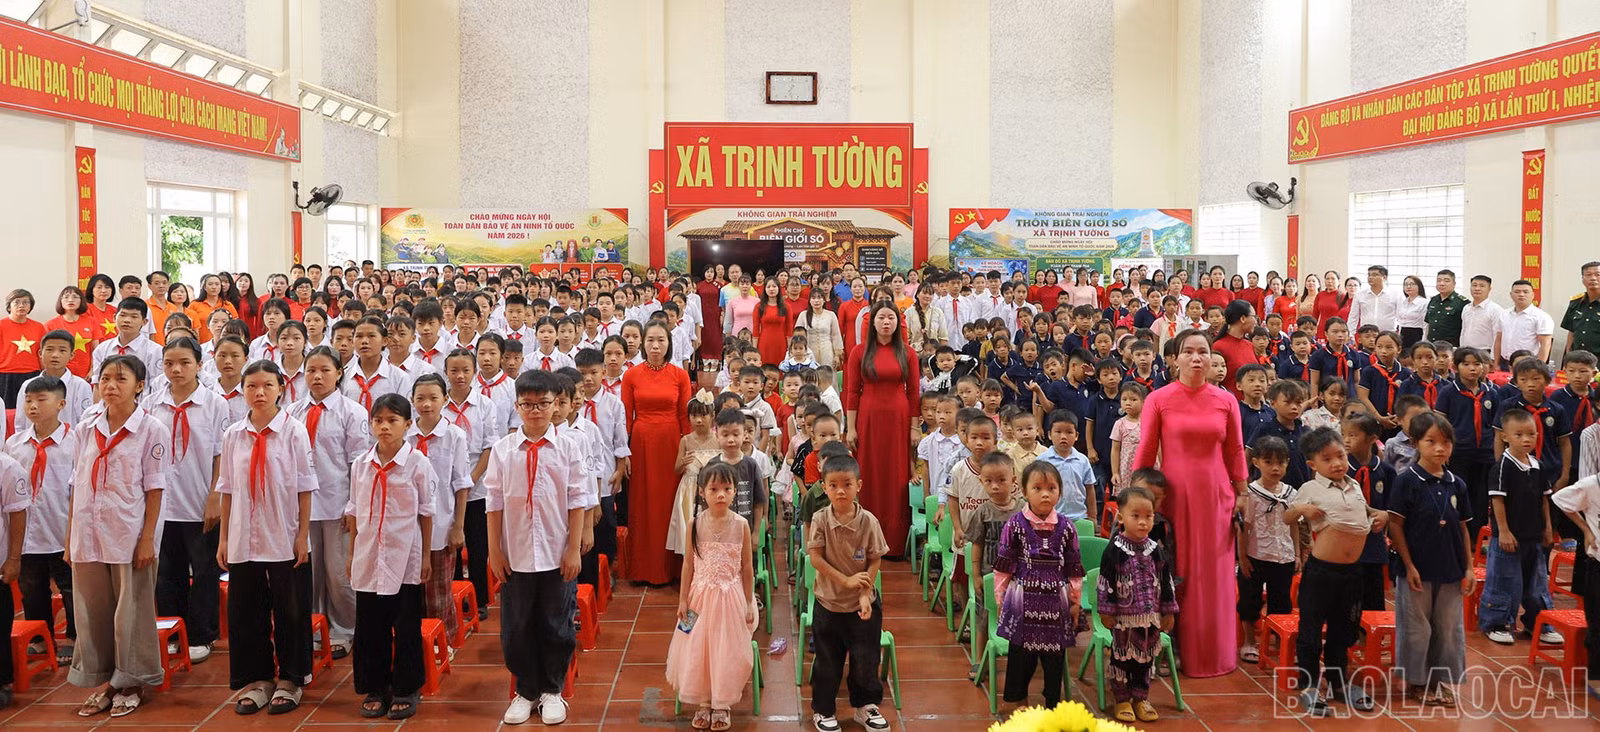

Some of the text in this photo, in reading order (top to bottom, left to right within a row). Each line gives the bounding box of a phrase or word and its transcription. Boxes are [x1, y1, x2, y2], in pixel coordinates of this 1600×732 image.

[10, 45, 41, 91] LÃNH
[44, 61, 70, 102] ĐẠO,
[72, 56, 86, 100] TỔ
[88, 67, 114, 108] CHỨC
[116, 79, 134, 118] MỌI
[136, 76, 164, 119] THẮNG
[166, 90, 178, 128] LỢI
[180, 88, 195, 126] CỦA
[1321, 110, 1339, 128] ĐẢNG
[1340, 109, 1350, 127] BỘ
[1352, 106, 1360, 121] VÀ
[1363, 100, 1383, 119] NHÂN
[1386, 94, 1402, 113] DÂN
[1405, 92, 1422, 110] CÁC
[1424, 84, 1444, 106] DÂN
[1446, 83, 1464, 106] TỘC
[1467, 77, 1481, 96] XÃ
[1484, 69, 1516, 95] TRỊNH
[1519, 58, 1558, 84] TƯỜNG
[1403, 118, 1417, 139] ĐẠI
[1420, 112, 1434, 134] HỘI
[1437, 108, 1463, 129] ĐẢNG
[1466, 102, 1480, 128] BỘ
[1483, 99, 1498, 122] XÃ
[1500, 91, 1522, 119] LẦN
[1526, 90, 1550, 113] THỨ
[1552, 96, 1559, 111] I,
[676, 135, 902, 197] XÃ TRỊNH TƯỜNG
[470, 212, 550, 221] CHÀO MỪNG NGÀY HỘI
[807, 210, 837, 218] NGHIỆM
[483, 221, 498, 229] BẢO
[500, 221, 509, 230] VỆ
[544, 221, 553, 229] TỔ
[555, 221, 574, 229] QUỐC
[1016, 217, 1127, 227] THÔN BIÊN GIỚI SỐ
[785, 232, 807, 243] GIỚI
[810, 233, 824, 243] SỐ
[1049, 230, 1075, 238] TRỊNH
